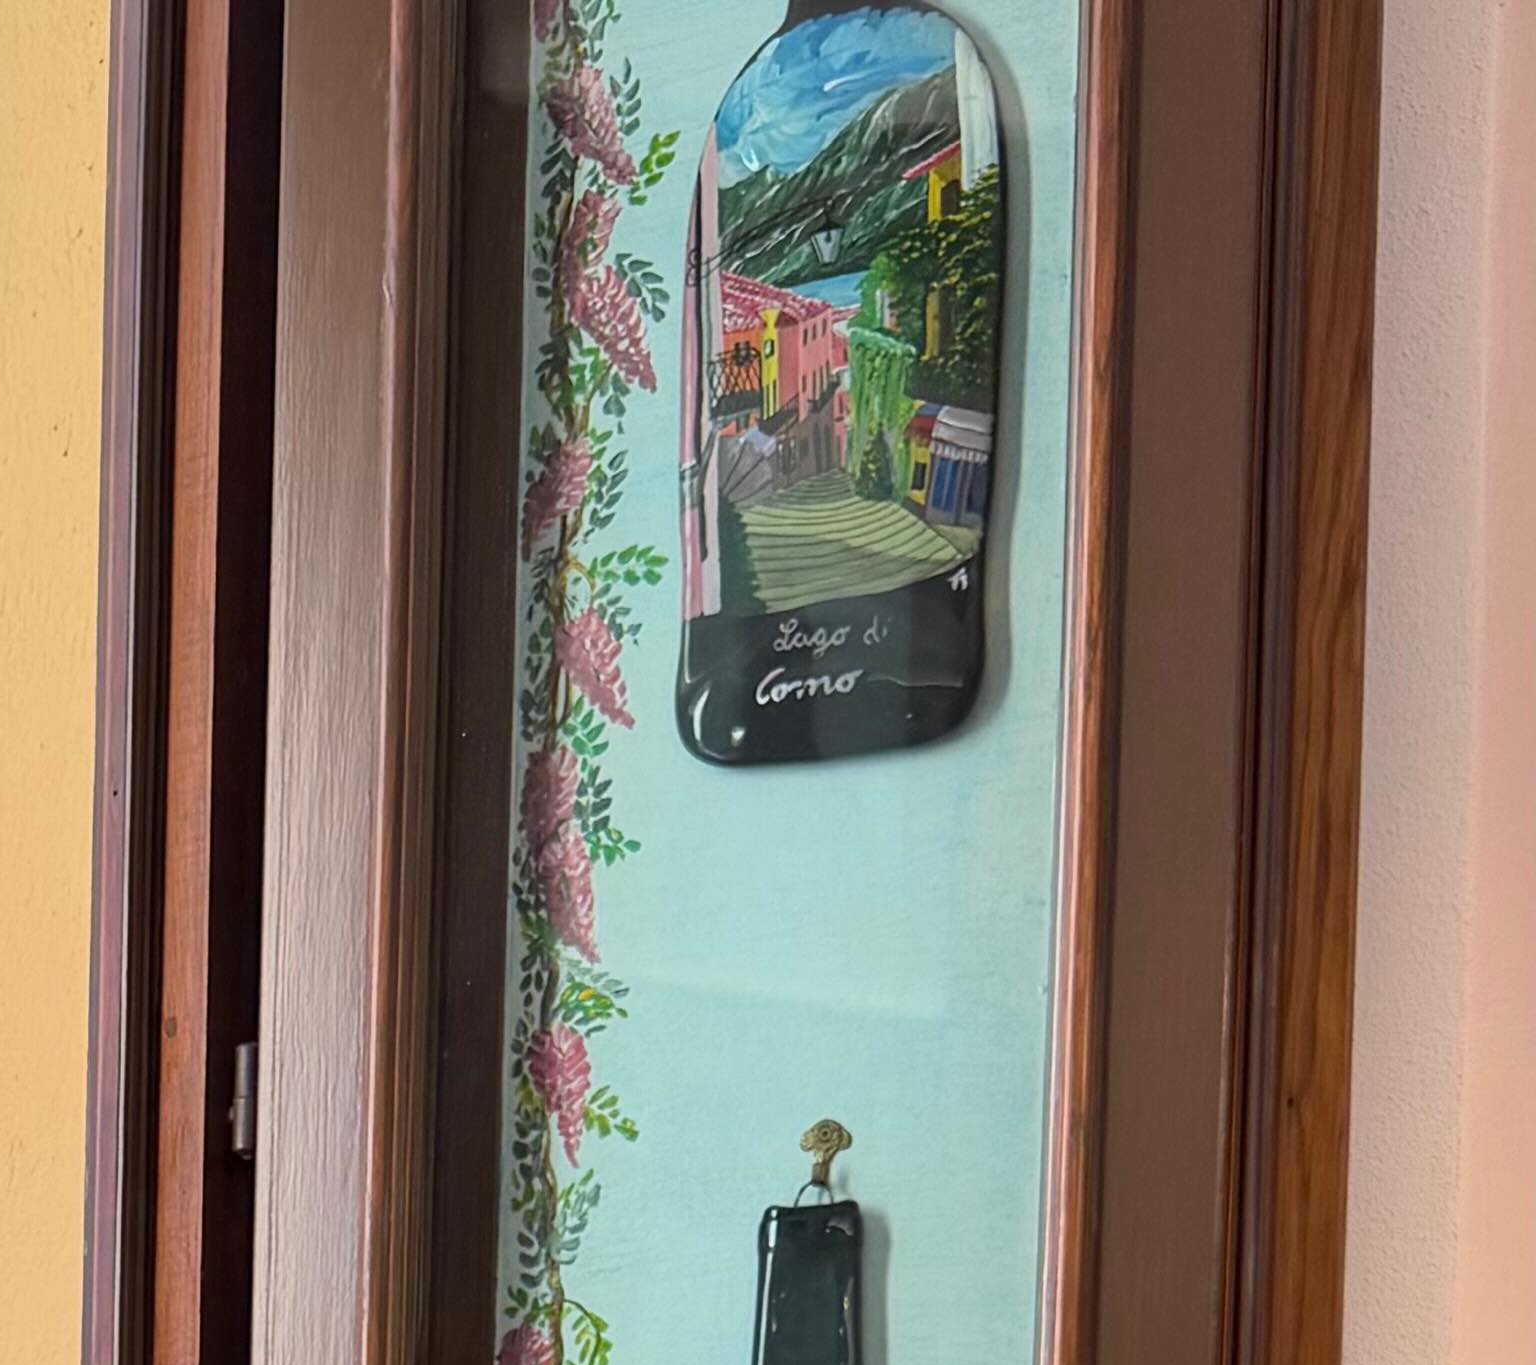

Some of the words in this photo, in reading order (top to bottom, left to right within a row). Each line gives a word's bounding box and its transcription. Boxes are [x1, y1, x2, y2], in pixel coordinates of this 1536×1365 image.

[772, 618, 851, 657] Lago
[863, 614, 890, 645] di
[756, 668, 864, 704] Como
